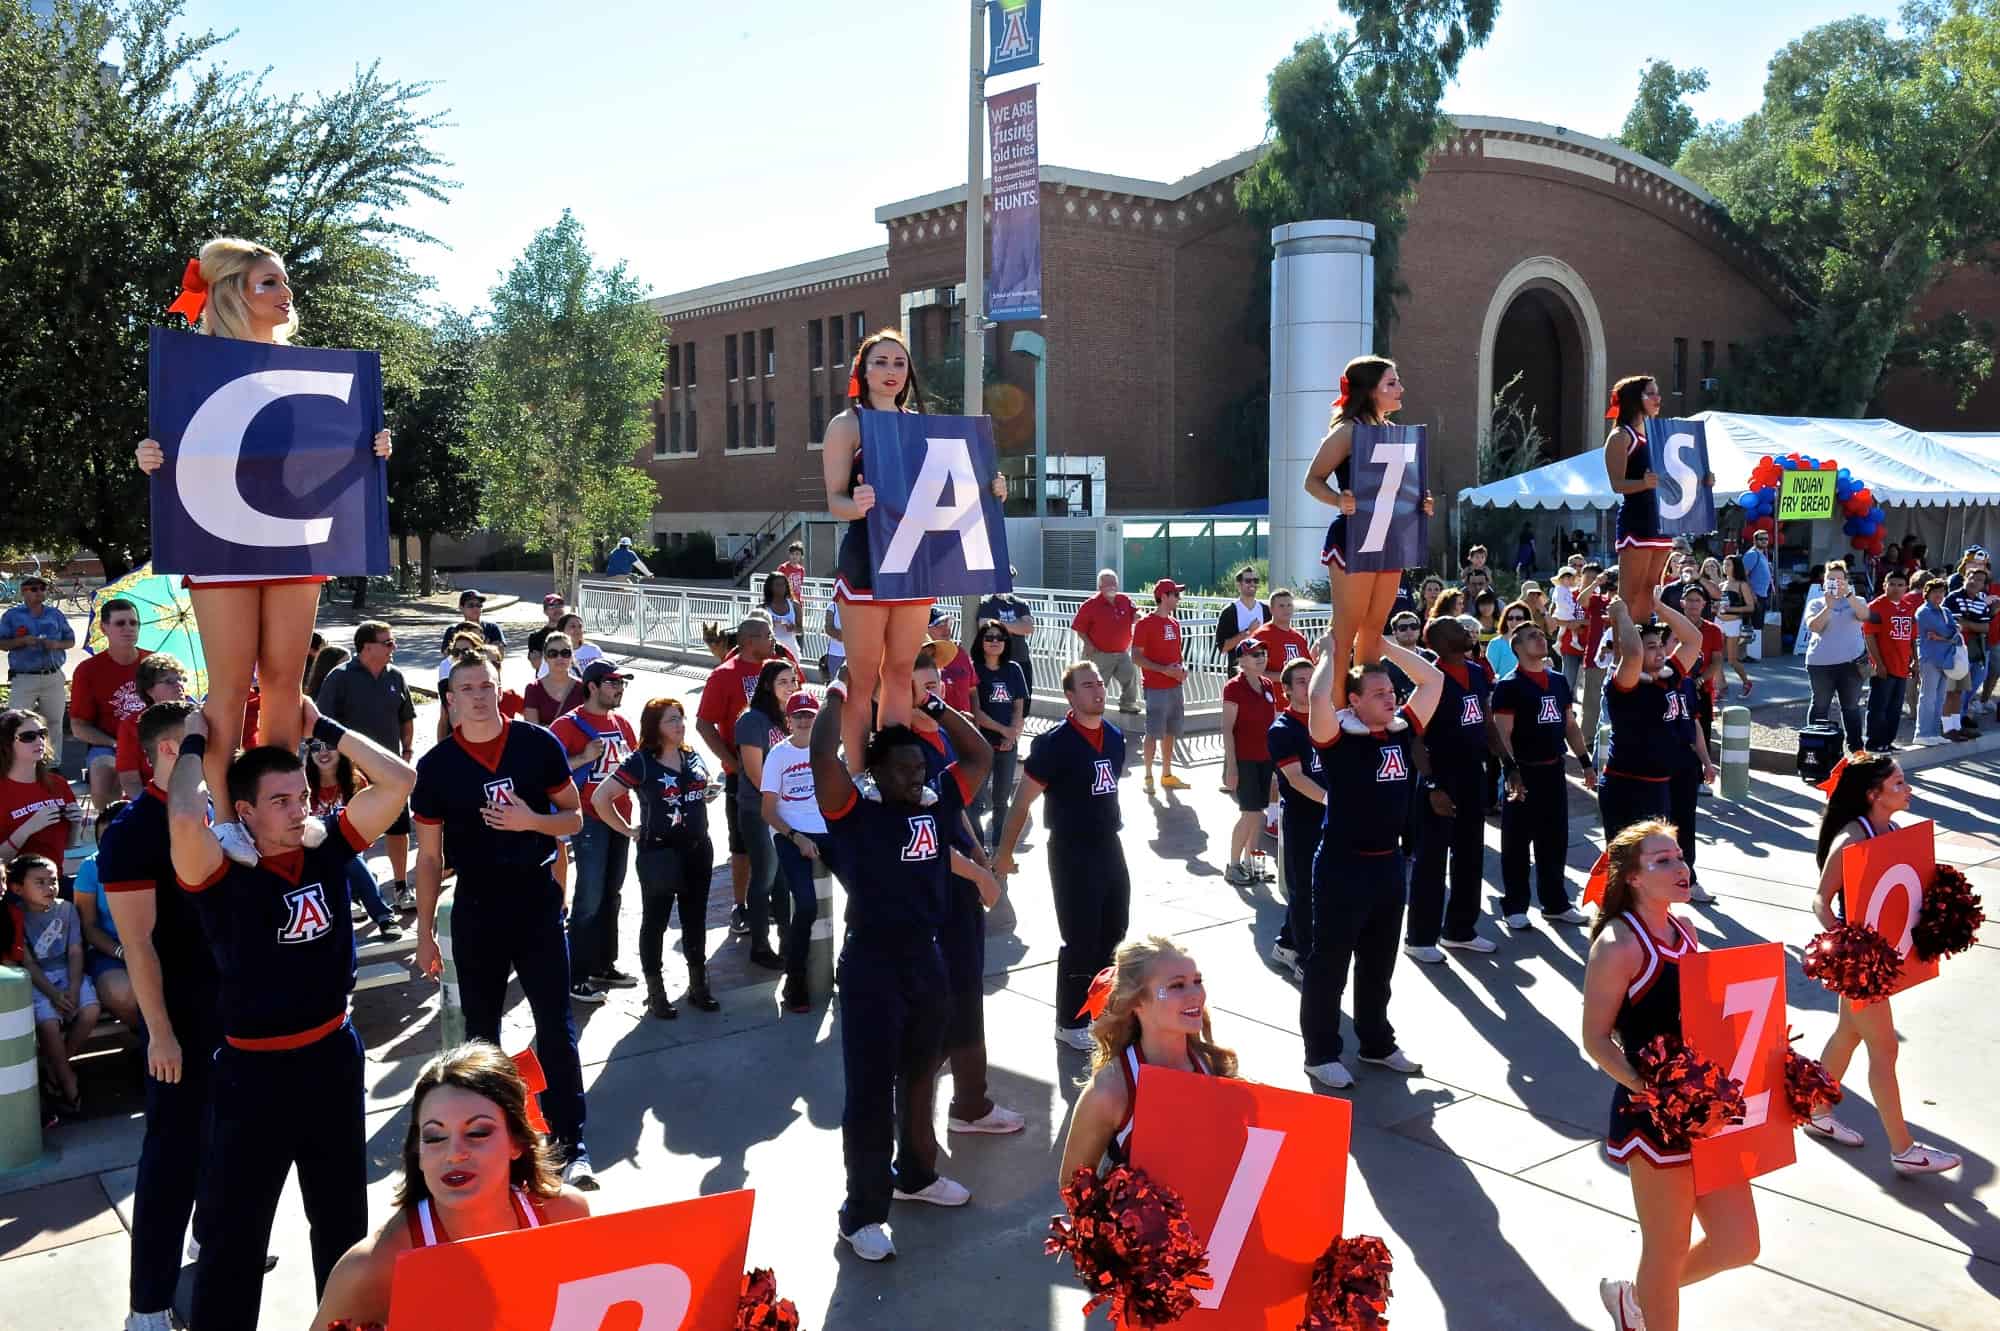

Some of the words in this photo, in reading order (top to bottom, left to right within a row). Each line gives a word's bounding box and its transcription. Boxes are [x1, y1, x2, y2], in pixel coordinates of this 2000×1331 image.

[994, 4, 1033, 64] A
[991, 106, 1010, 124] WE
[1011, 100, 1033, 118] ARE
[993, 120, 1034, 150] fusing
[993, 146, 1010, 163] old
[1012, 143, 1035, 159] tires
[994, 190, 1039, 211] HUNTS.
[176, 369, 354, 547] C
[1659, 433, 1698, 520] S
[1792, 477, 1824, 493] INDIAN
[879, 438, 995, 574] A
[1358, 443, 1416, 553] T
[1781, 496, 1799, 512] FRY
[1800, 495, 1830, 512] BREAD
[1461, 695, 1484, 726] A
[1538, 696, 1562, 724] A
[1091, 760, 1117, 795] A
[1376, 745, 1408, 782] A
[901, 815, 938, 861] A
[278, 882, 333, 943] A
